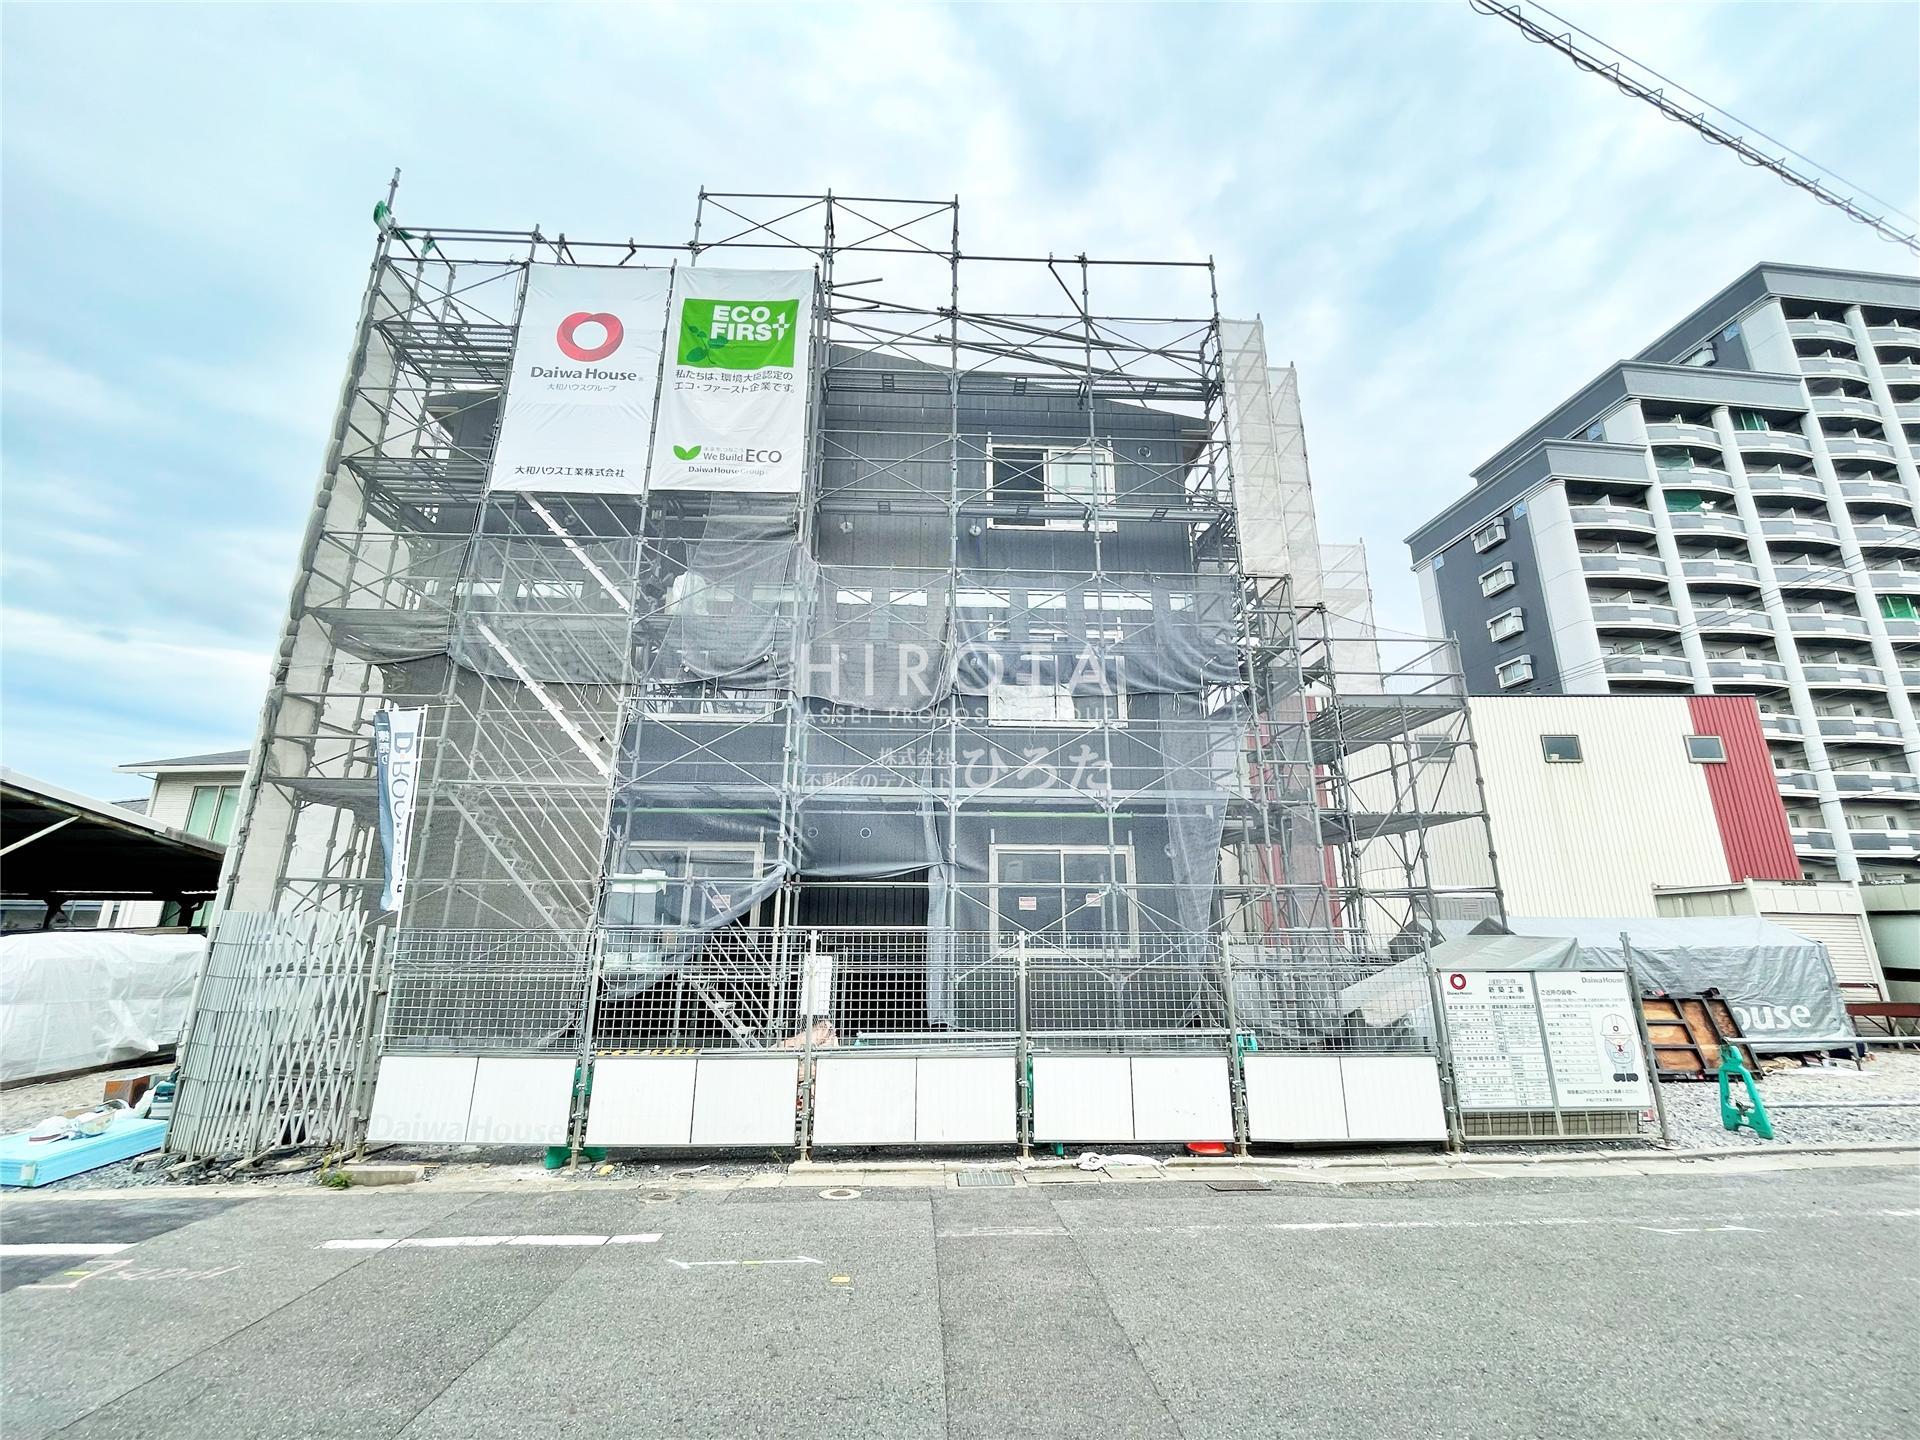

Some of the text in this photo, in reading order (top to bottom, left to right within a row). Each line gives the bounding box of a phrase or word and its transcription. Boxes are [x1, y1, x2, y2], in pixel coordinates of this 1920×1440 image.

[712, 305, 771, 322] ECO
[710, 312, 790, 341] FIRST
[530, 366, 638, 381] Daiwa House
[675, 369, 794, 383] 私たちは、環境大臣認定の
[546, 383, 617, 392] 大和ハウスグループ
[673, 381, 795, 393] エコ・ファースト企業です。
[703, 449, 783, 463] We Build ECO
[514, 465, 625, 478] 大和ハウス工業株式会社
[1732, 1005, 1811, 1030] ouse
